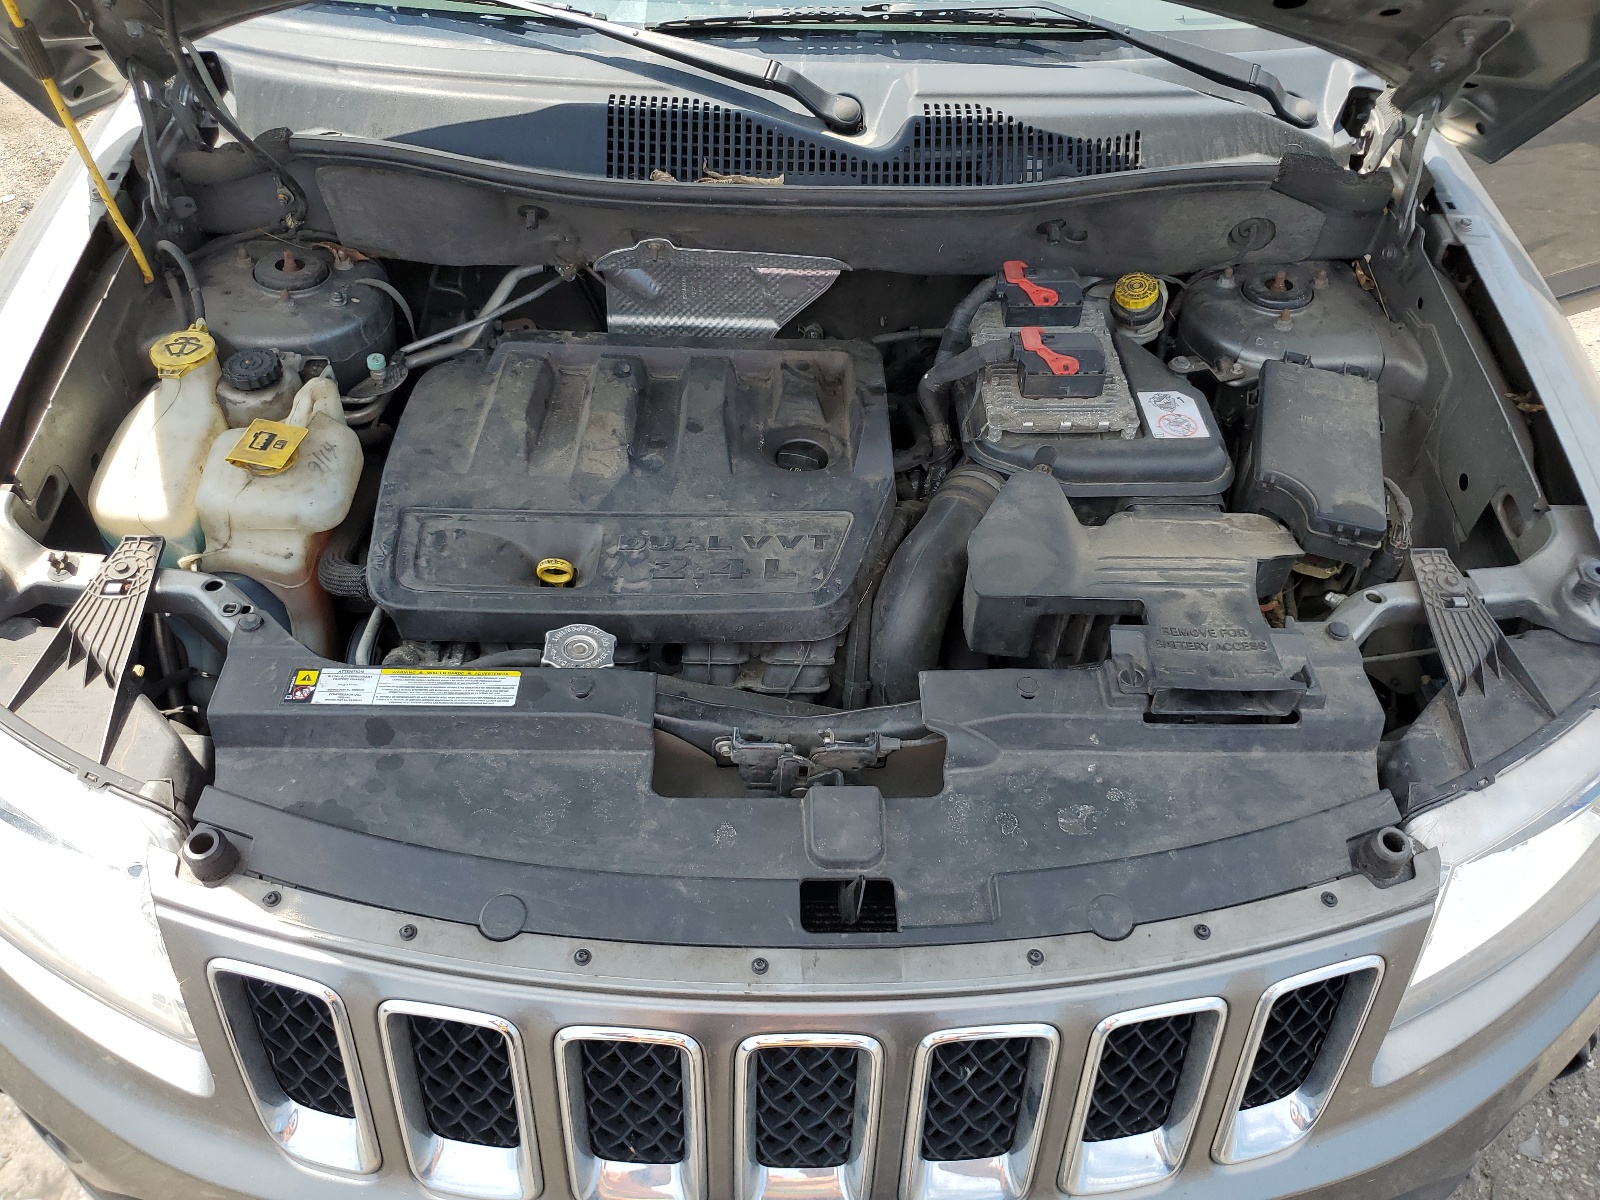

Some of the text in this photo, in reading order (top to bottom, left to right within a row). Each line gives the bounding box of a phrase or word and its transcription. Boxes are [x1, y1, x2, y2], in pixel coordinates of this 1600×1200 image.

[617, 533, 832, 552] DUAL VVT
[1161, 626, 1248, 639] REMOVE FOR
[1155, 639, 1268, 652] BATTERY ACCESS
